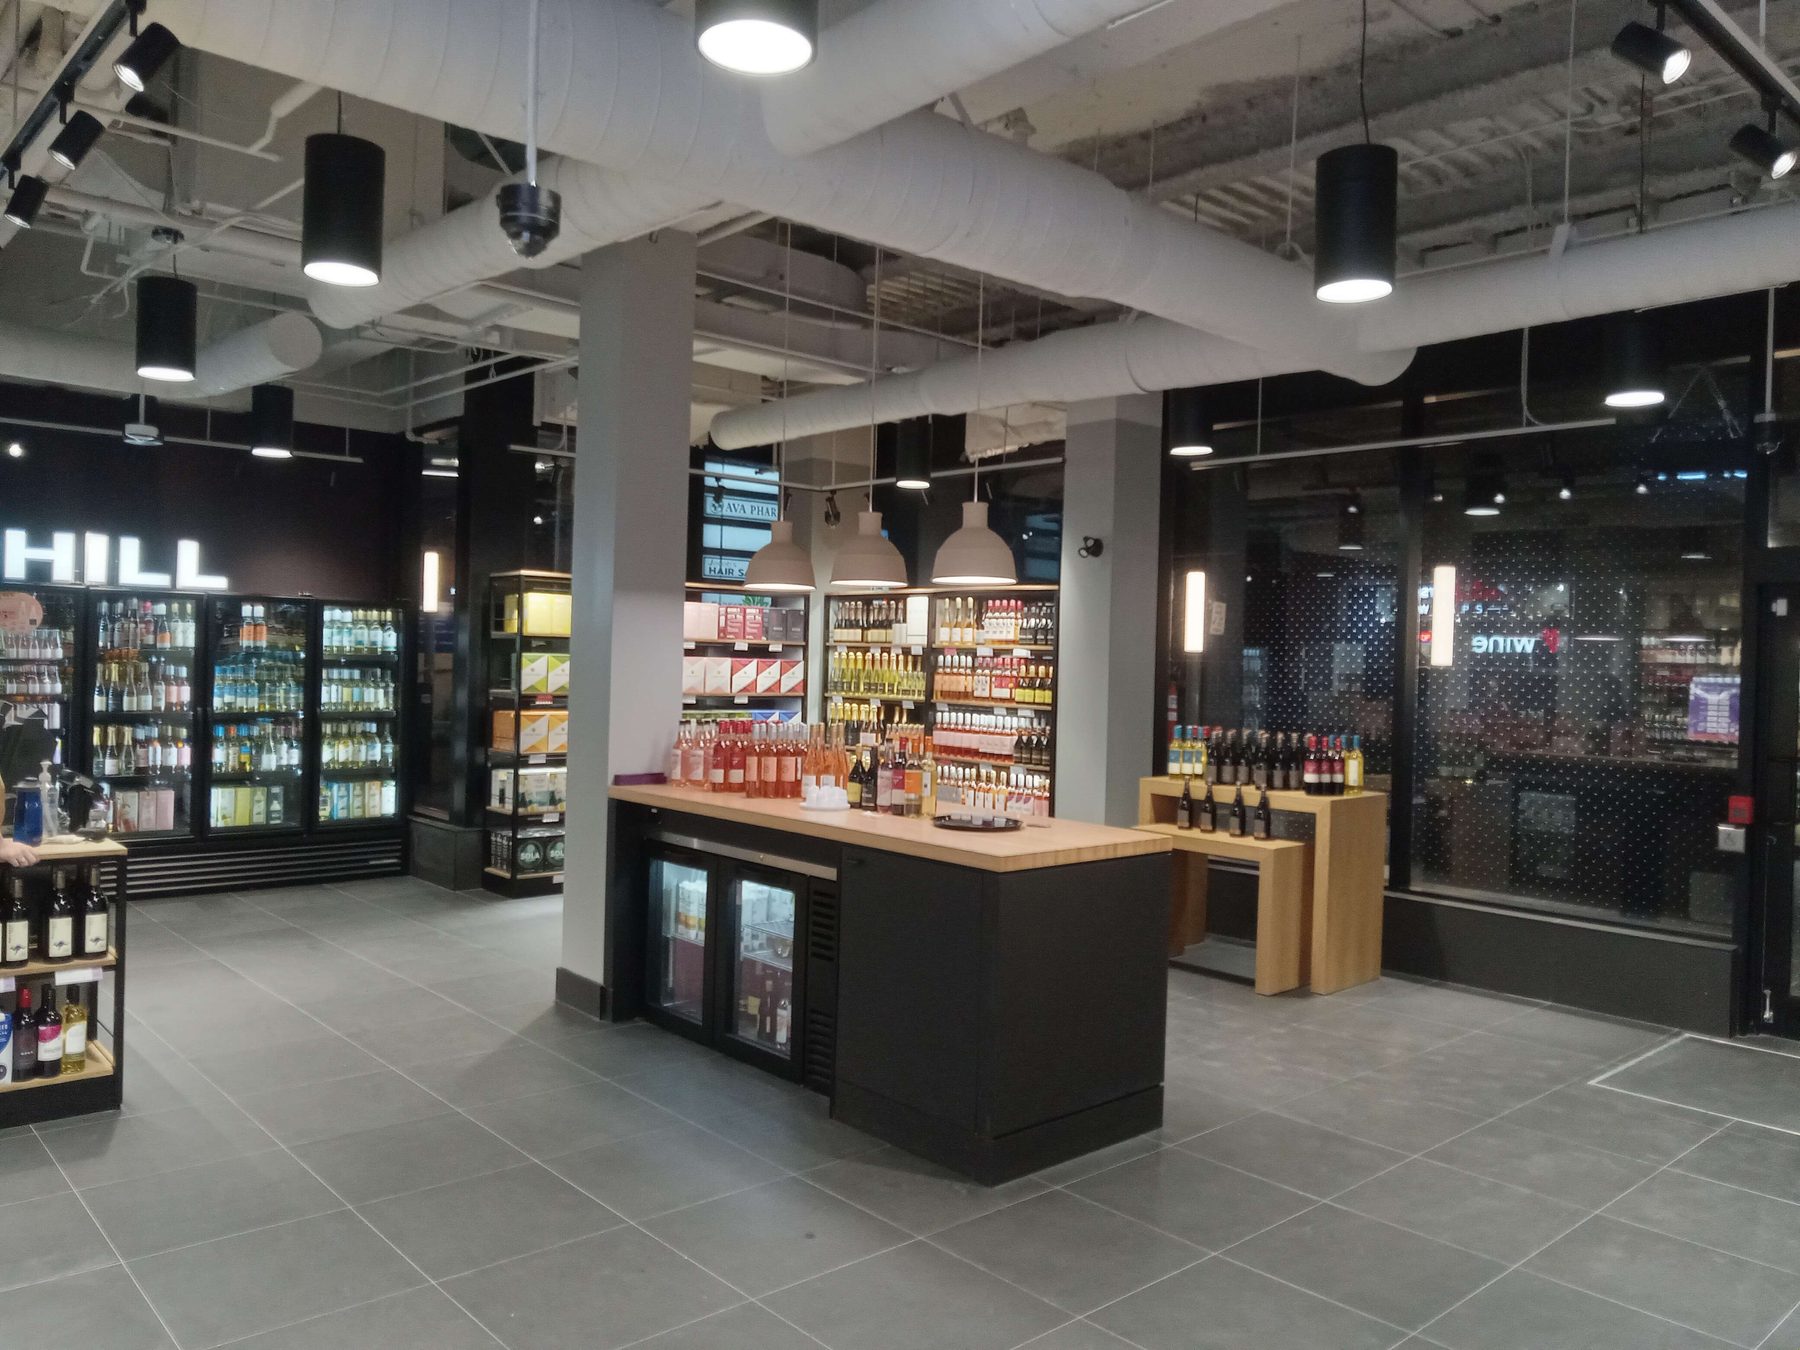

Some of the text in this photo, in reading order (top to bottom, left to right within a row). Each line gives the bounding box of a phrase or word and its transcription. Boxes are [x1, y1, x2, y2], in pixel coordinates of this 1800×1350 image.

[725, 502, 747, 515] AVA
[4, 529, 228, 591] HILL
[708, 566, 734, 577] HAIR
